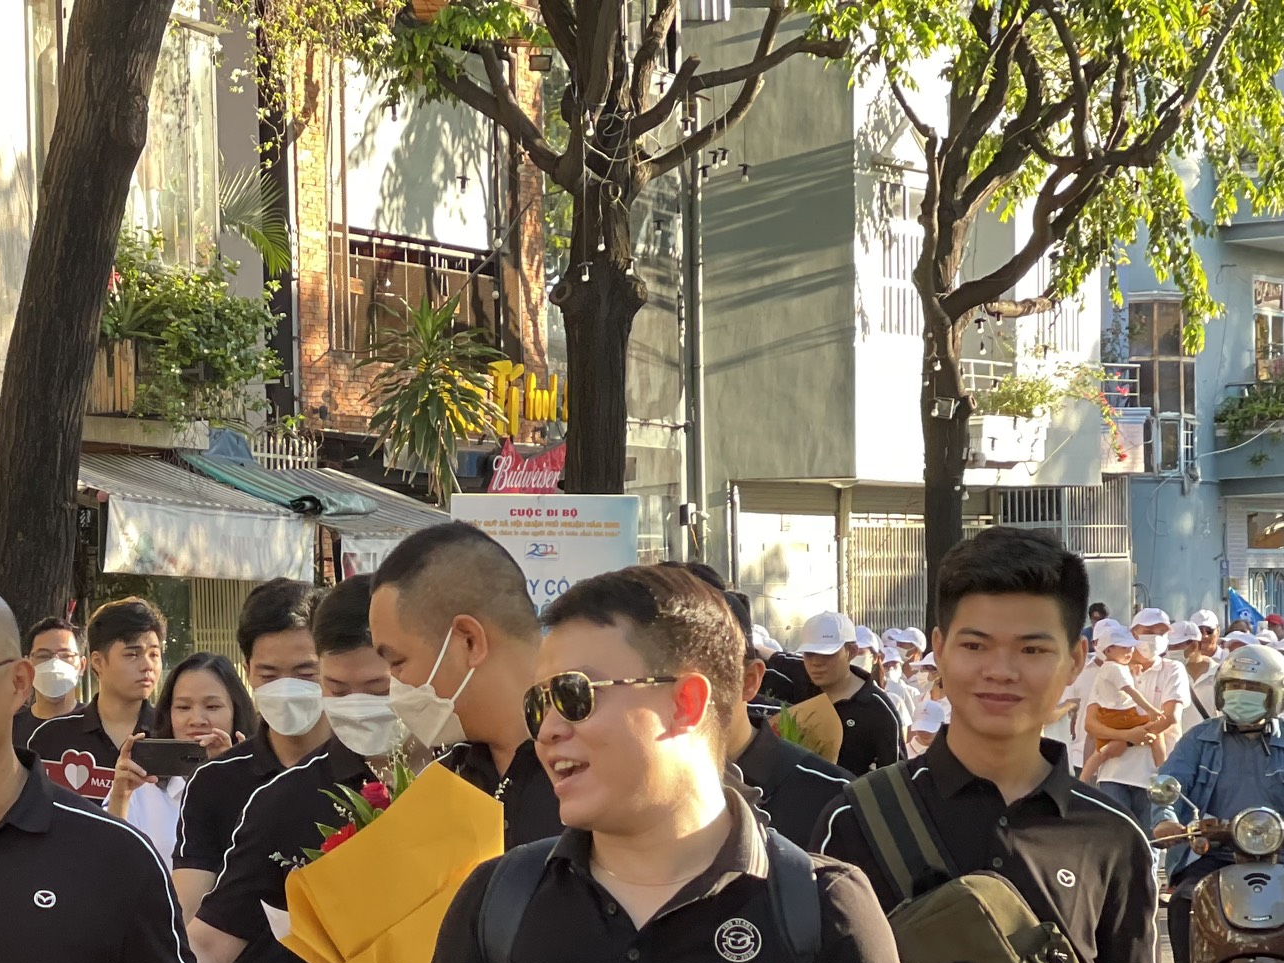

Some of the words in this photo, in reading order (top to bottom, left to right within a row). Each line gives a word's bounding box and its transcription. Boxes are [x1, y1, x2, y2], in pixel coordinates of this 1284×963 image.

[492, 453, 560, 491] Budweiser
[509, 507, 542, 519] CUỘC
[546, 508, 558, 517] ĐI
[562, 507, 578, 519] BỘ
